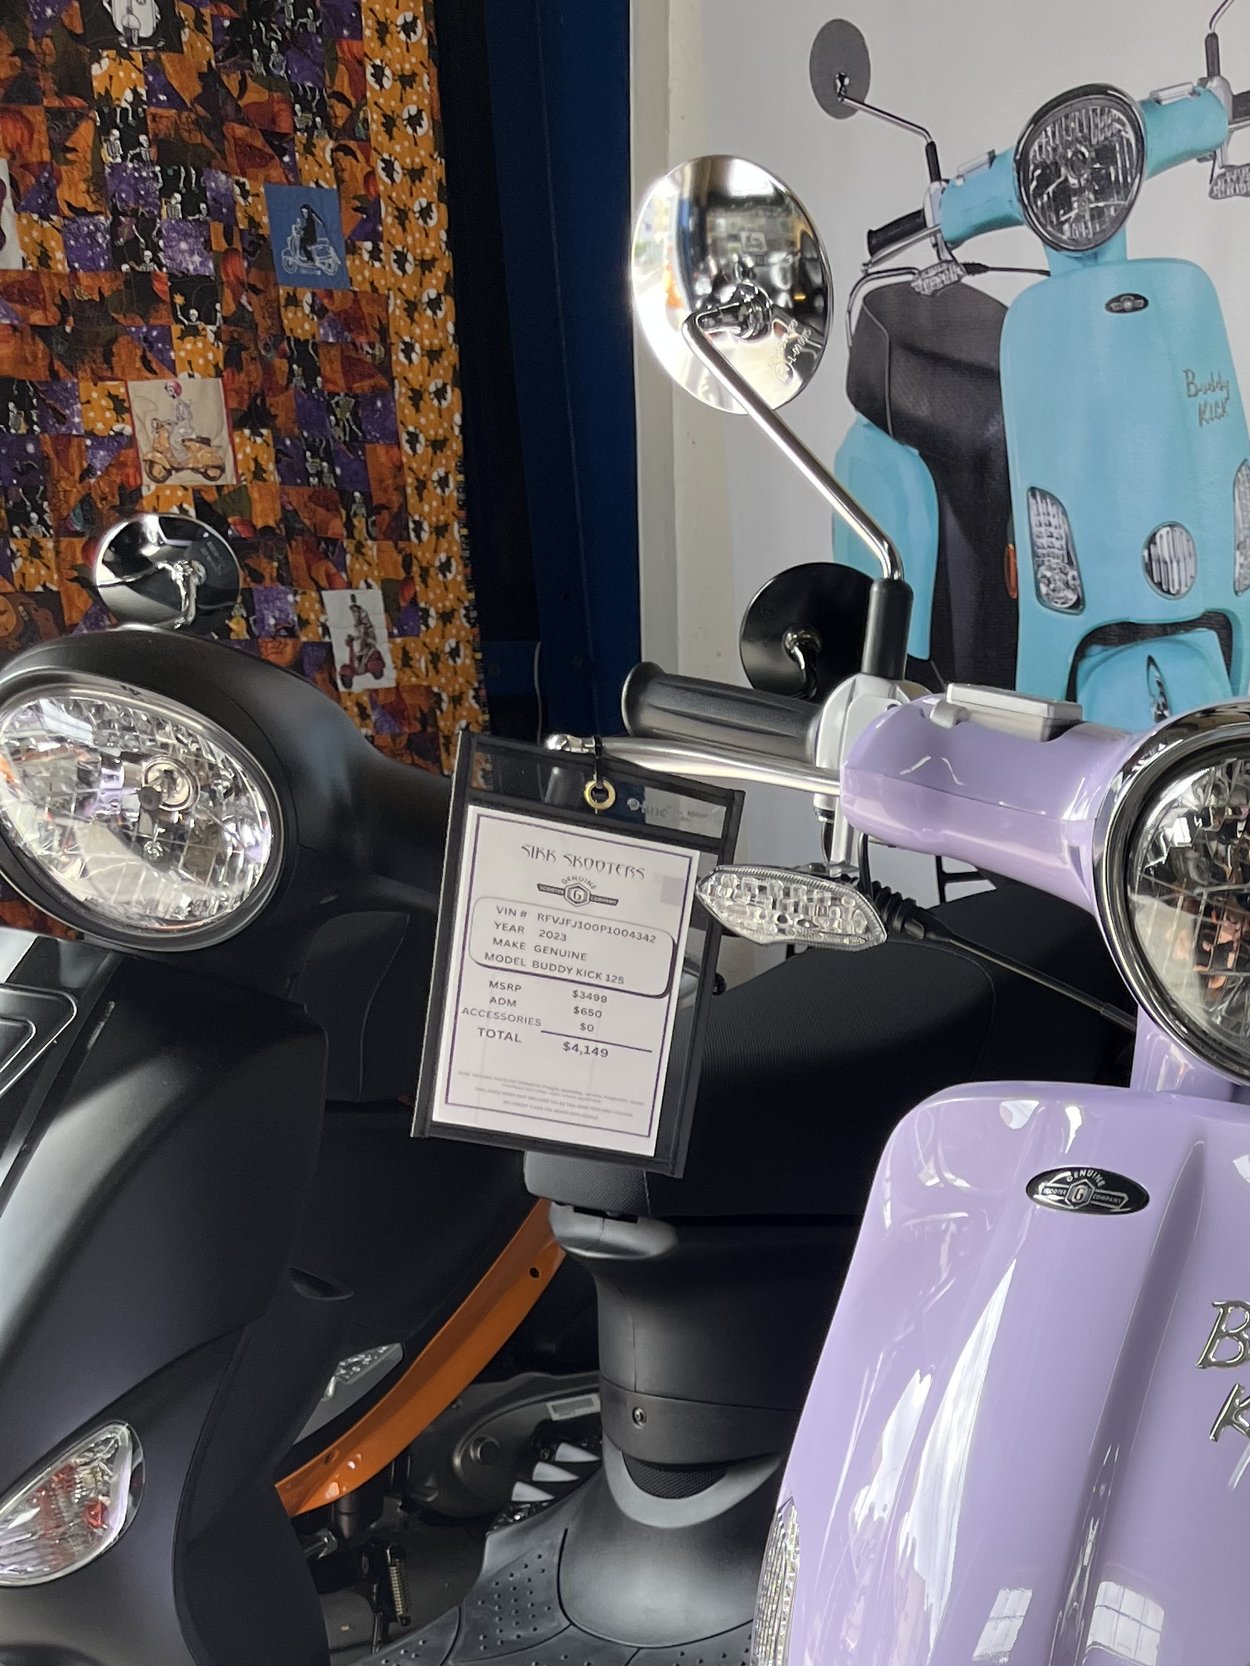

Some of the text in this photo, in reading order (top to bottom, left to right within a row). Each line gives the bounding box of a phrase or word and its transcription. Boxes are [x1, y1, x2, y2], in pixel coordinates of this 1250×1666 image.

[1182, 368, 1230, 400] Buddy
[1198, 399, 1229, 428] KICK
[521, 844, 645, 880] SIKK SKOOTERS
[496, 905, 517, 917] VIN
[520, 909, 527, 918] #
[494, 920, 567, 942] YEAR 2023
[492, 936, 587, 961] MAKE GENUINE
[484, 952, 624, 985] MODEL BUDDY KICK 125
[489, 980, 608, 1004] MSRP $3499
[461, 1007, 595, 1033] ACCESSORIES $0
[489, 996, 603, 1019] ADM $650
[477, 1027, 609, 1058] TOTAL $4,149
[1066, 1169, 1105, 1187] GENUINE
